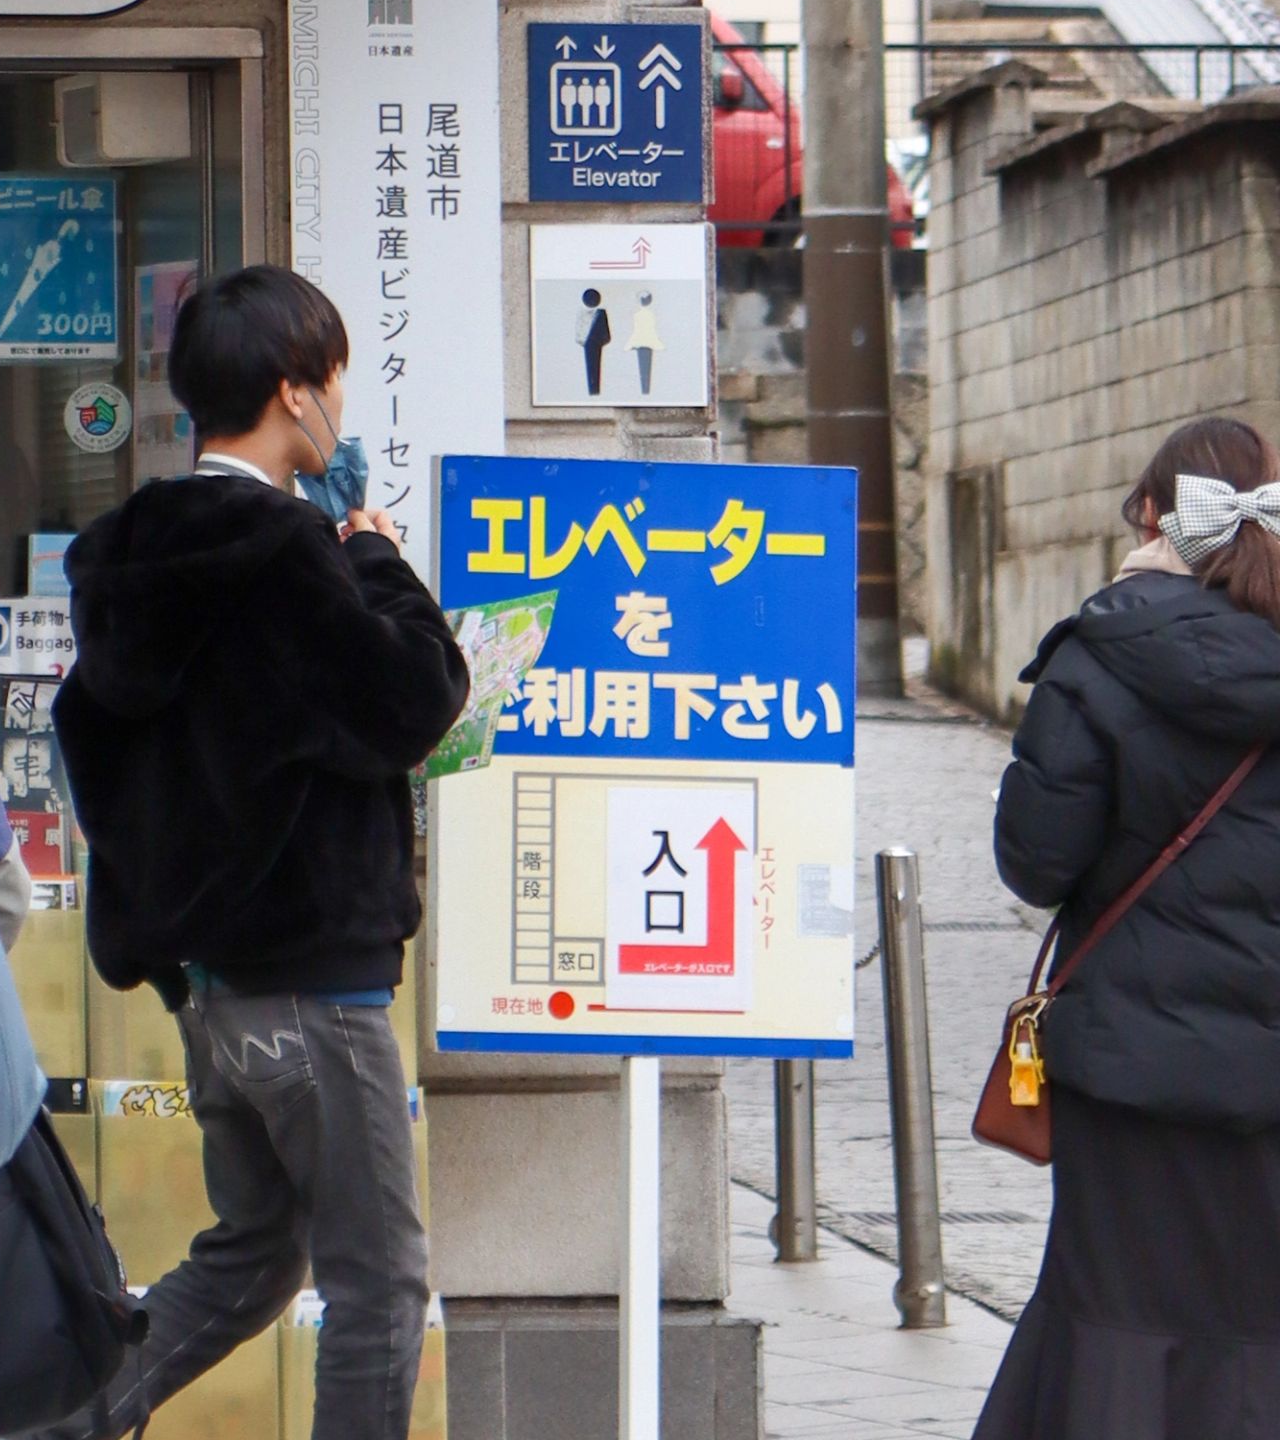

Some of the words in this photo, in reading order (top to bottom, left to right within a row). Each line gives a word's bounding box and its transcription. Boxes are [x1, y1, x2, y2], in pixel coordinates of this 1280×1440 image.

[367, 45, 415, 57] 日本遺産
[426, 102, 461, 221] 尾道市
[548, 141, 685, 165] エレベーター
[295, 146, 322, 242] CITY
[571, 167, 662, 189] Elevator
[296, 254, 323, 288] H
[36, 311, 113, 337] 300円
[467, 496, 826, 587] エレベーター
[612, 591, 673, 659] を
[15, 635, 75, 653] Baggag
[522, 851, 543, 902] 階段
[640, 828, 689, 935] 入口
[758, 846, 778, 951] エレベーター
[557, 951, 596, 972] 窓口
[490, 996, 544, 1015] 現在地
